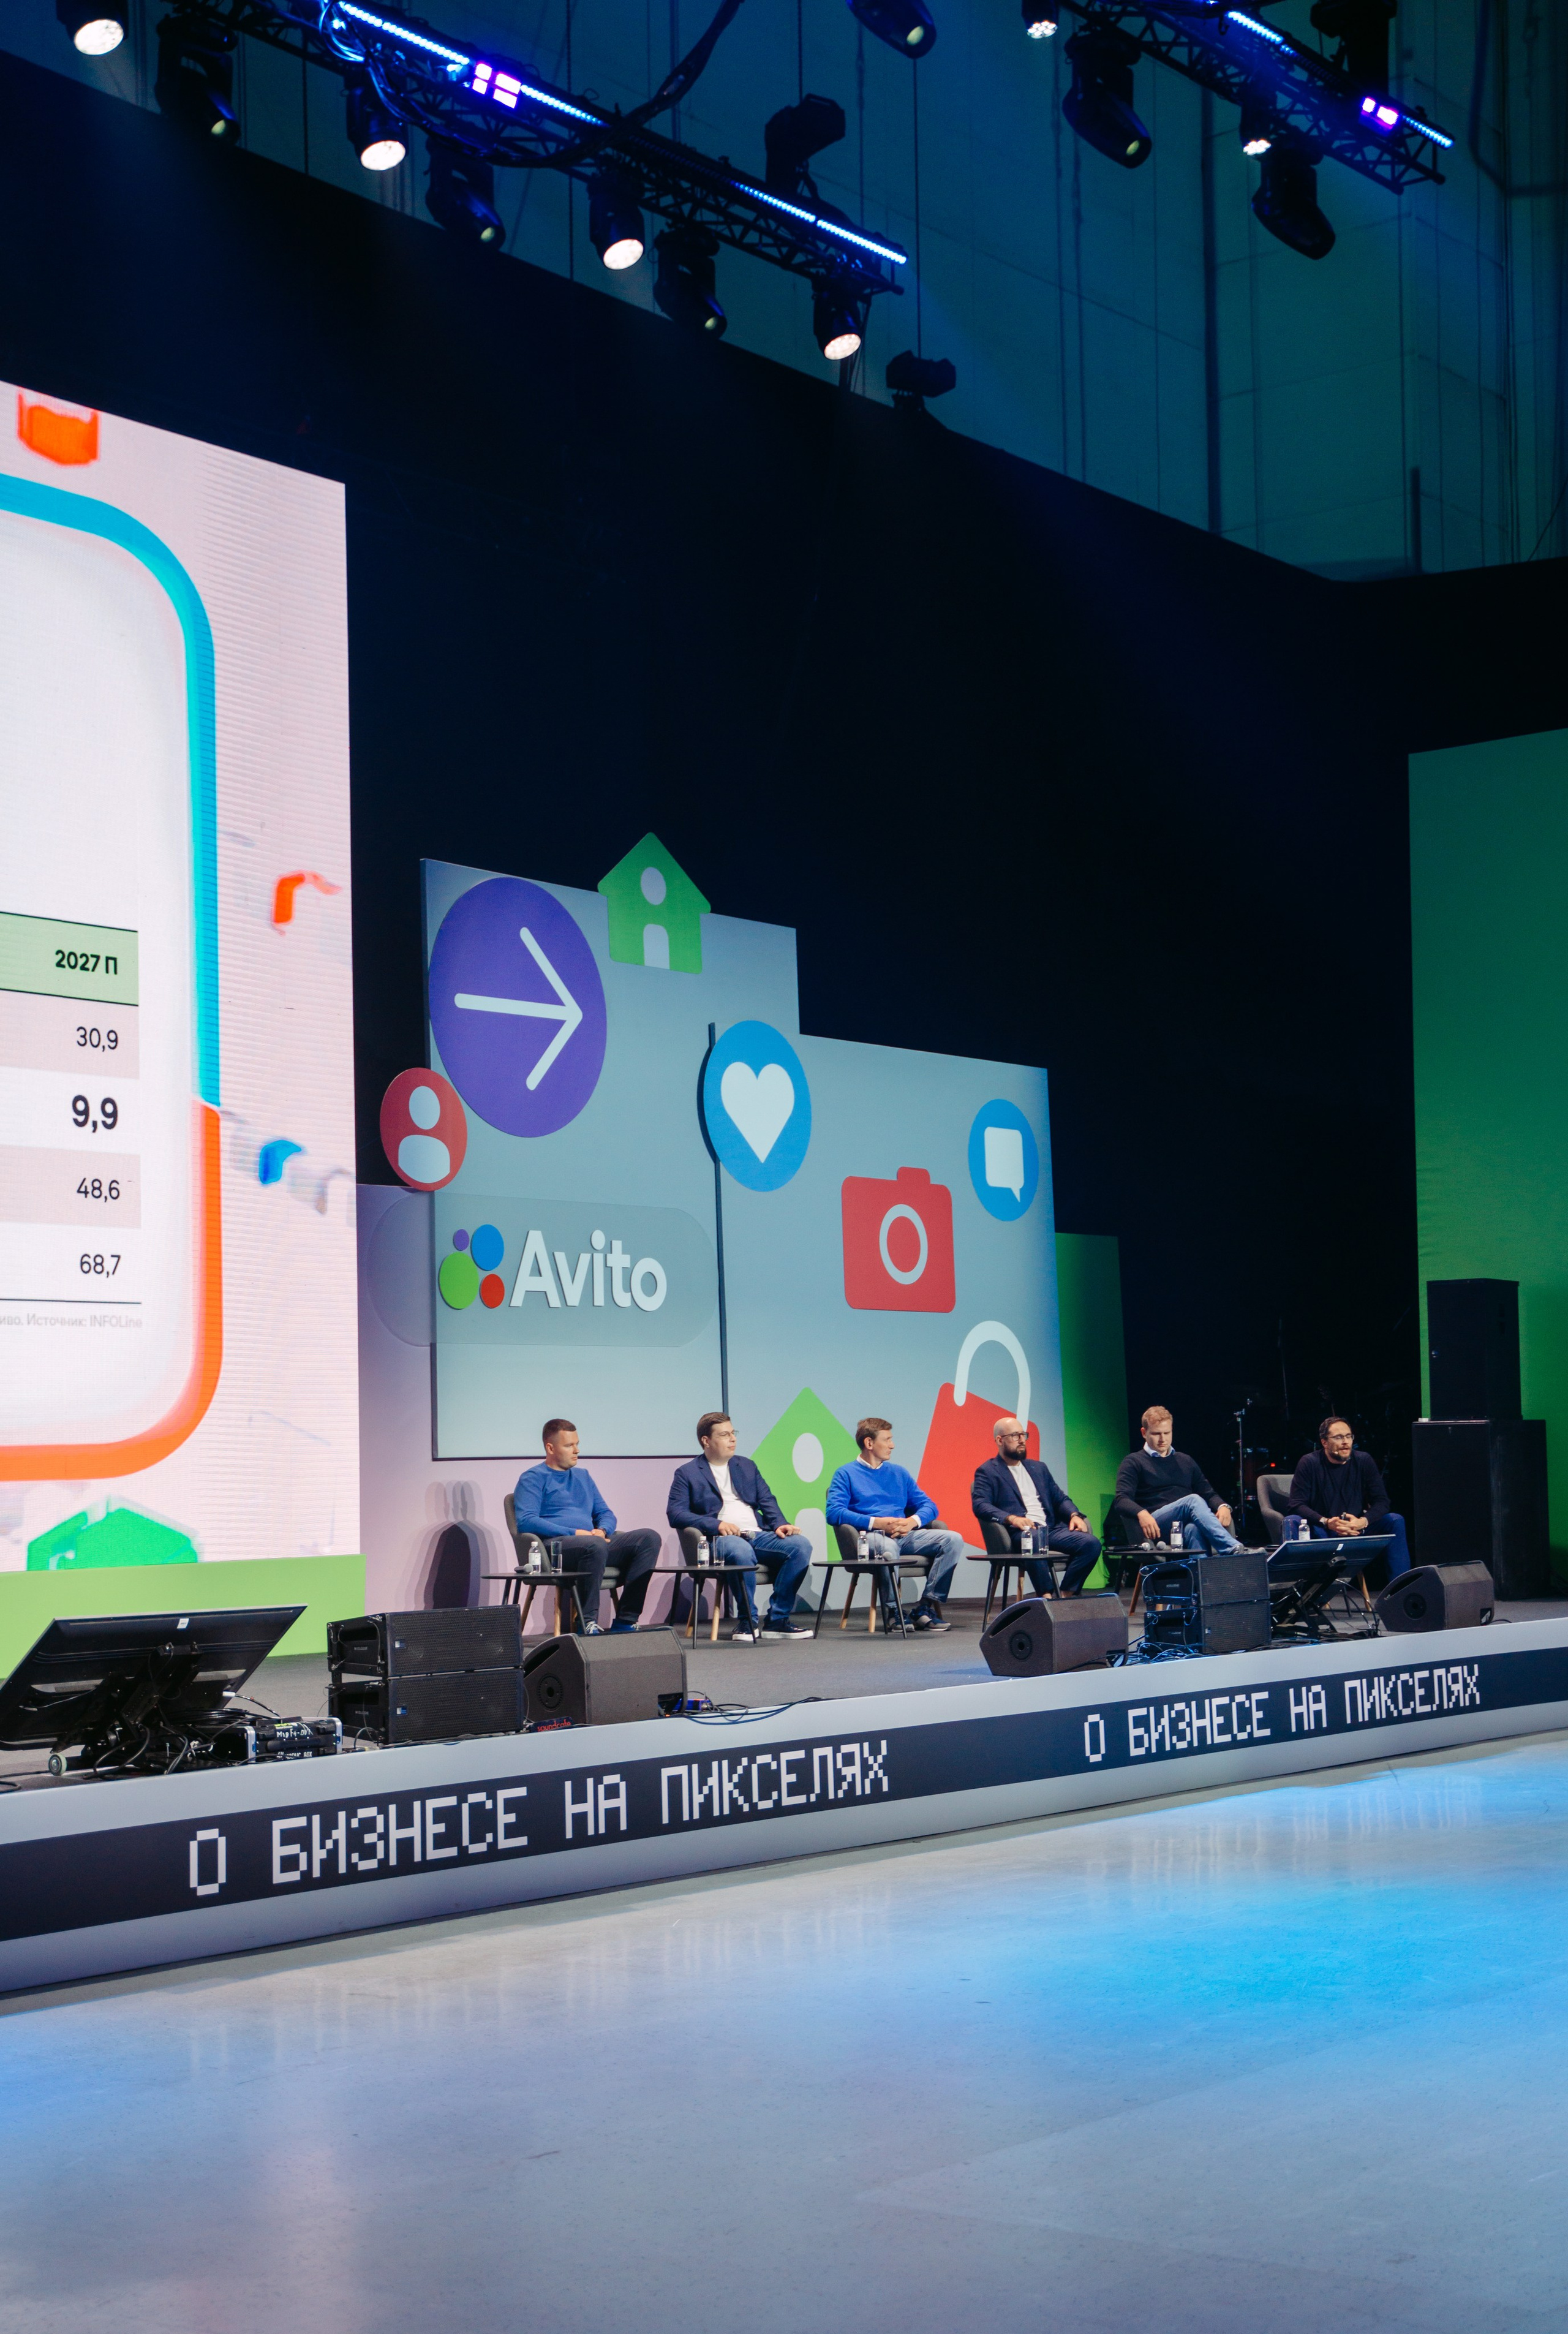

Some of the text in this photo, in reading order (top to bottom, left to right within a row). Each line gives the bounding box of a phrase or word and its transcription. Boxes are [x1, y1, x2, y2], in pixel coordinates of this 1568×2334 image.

[55, 950, 118, 975] 2027 П
[76, 1026, 118, 1052] 30,9
[72, 1095, 118, 1133] 9,9
[76, 1177, 120, 1203] 48,6
[80, 1253, 121, 1278] 68,7
[509, 1229, 667, 1312] Avito
[27, 1313, 86, 1327] Источник:
[90, 1315, 142, 1328] INFOLine
[1084, 1664, 1480, 1762] О БИЗНЕСЕ НА ПИКСЕЛЯХ
[189, 1739, 889, 1896] О БИЗНЕСЕ НА ПИКСЕЛЯХ
